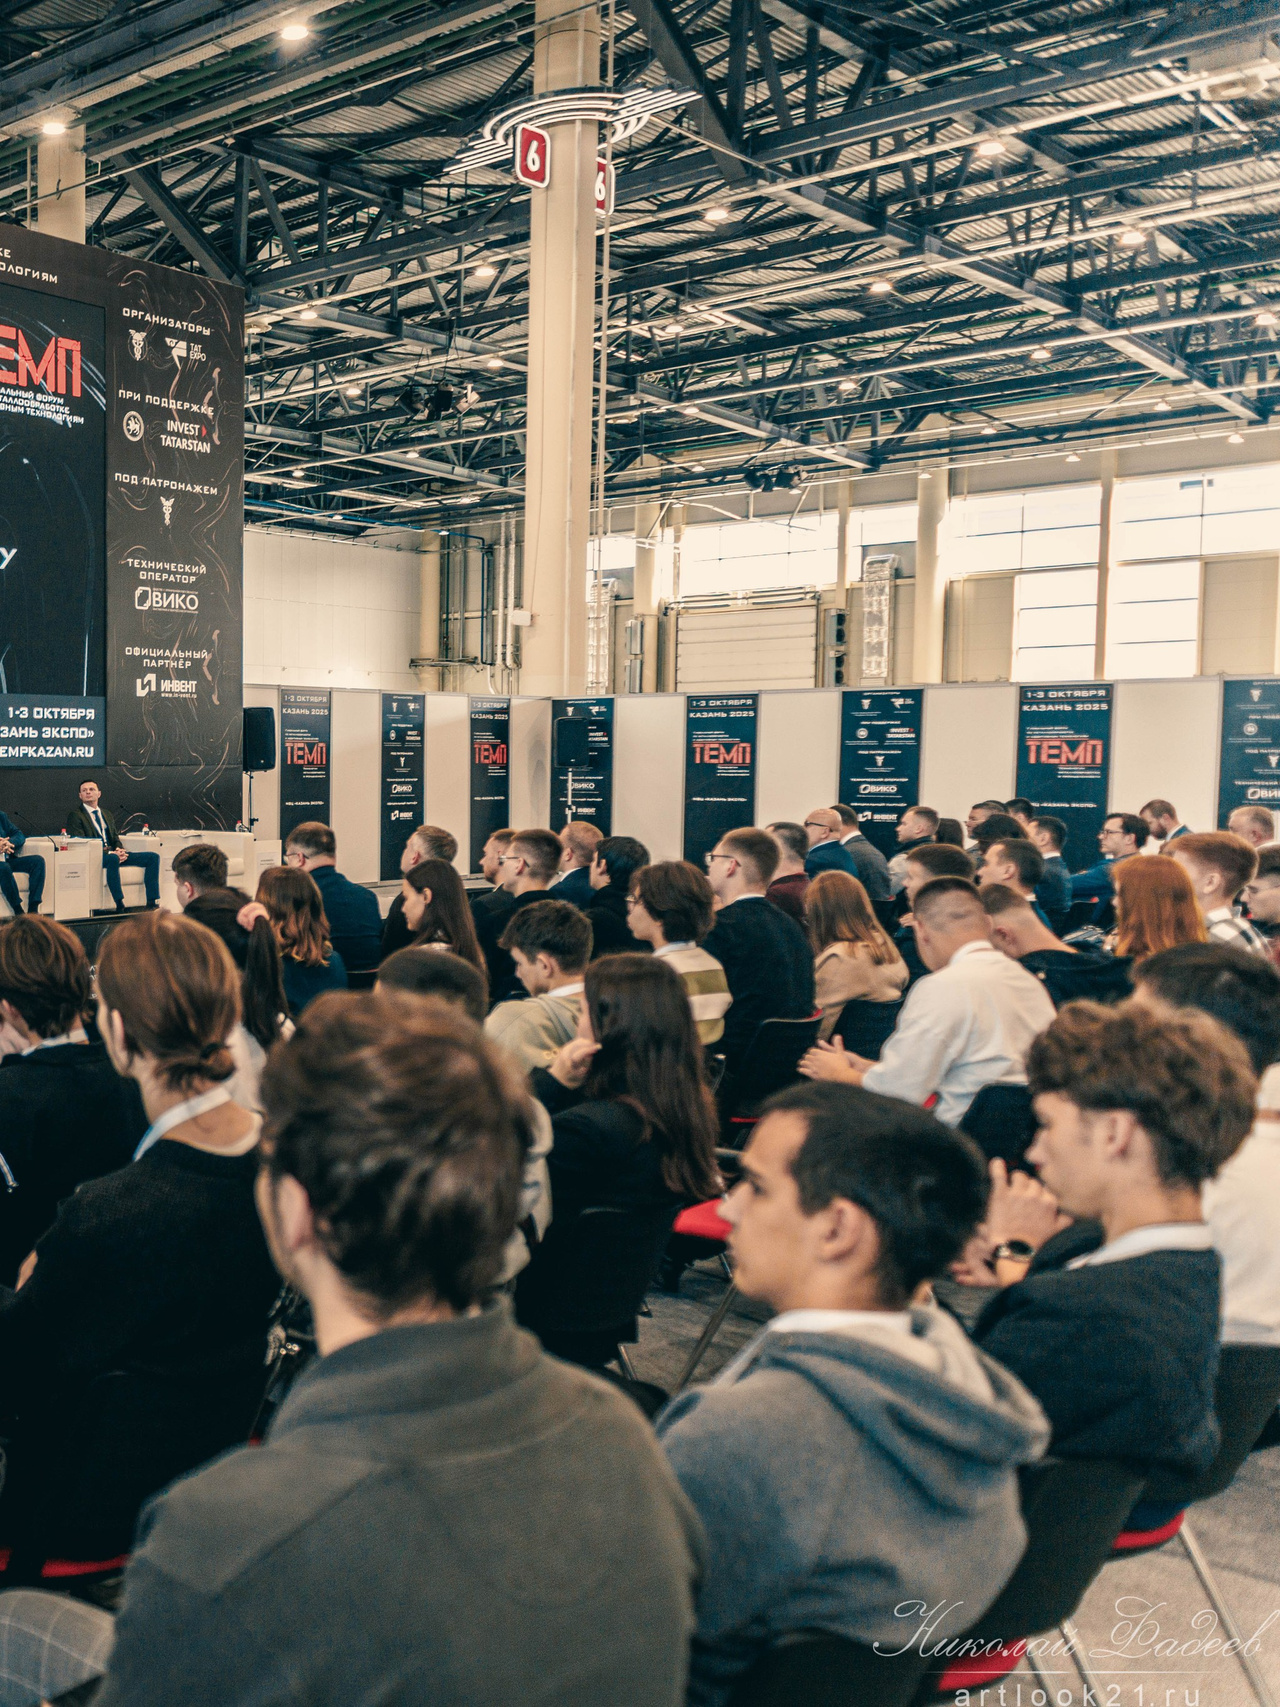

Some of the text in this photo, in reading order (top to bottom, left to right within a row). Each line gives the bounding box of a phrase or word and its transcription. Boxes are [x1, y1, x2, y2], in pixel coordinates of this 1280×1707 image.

[526, 140, 541, 172] 6
[594, 171, 606, 201] 6
[122, 307, 212, 336] ОРГАНИЗАТОРЫ
[189, 342, 203, 353] TAT
[189, 351, 207, 362] EXPO
[36, 393, 64, 405] ФОРУМ
[118, 389, 215, 416] ПРИ ПОДДЕРЖКЕ
[25, 407, 85, 425] ТЕХНОЛОГИЯМ
[167, 419, 200, 436] INVEST
[160, 435, 211, 454] TATARSTAN
[115, 472, 218, 496] ПОД ПАТРОНАЖЕМ
[127, 558, 207, 575] ТЕХНИЧЕСКИЙ
[139, 571, 197, 584] ОПЕРАТОР
[152, 591, 199, 611] ВИКО
[125, 646, 208, 659] ОФИЦИАЛЬНЫЙ
[143, 658, 192, 669] ПАРТНЁР
[160, 679, 197, 693] ИНВЕНТ
[1048, 689, 1106, 698] ОКТЯБРЯ
[708, 698, 753, 707] ОКТЯБРЯ
[1074, 703, 1109, 711] 2025
[7, 706, 95, 720] 1-3 ОКТЯБРЯ
[282, 707, 329, 716] КАЗАНЬ 2025
[41, 727, 95, 739] ЭКСПО»
[284, 742, 327, 765] ТЕМП
[473, 743, 507, 764] ТЕМП
[692, 742, 751, 764] ТЕМП
[1025, 739, 1103, 764] ТЕМП
[574, 782, 596, 790] ВИКО
[870, 785, 898, 793] ВИКО
